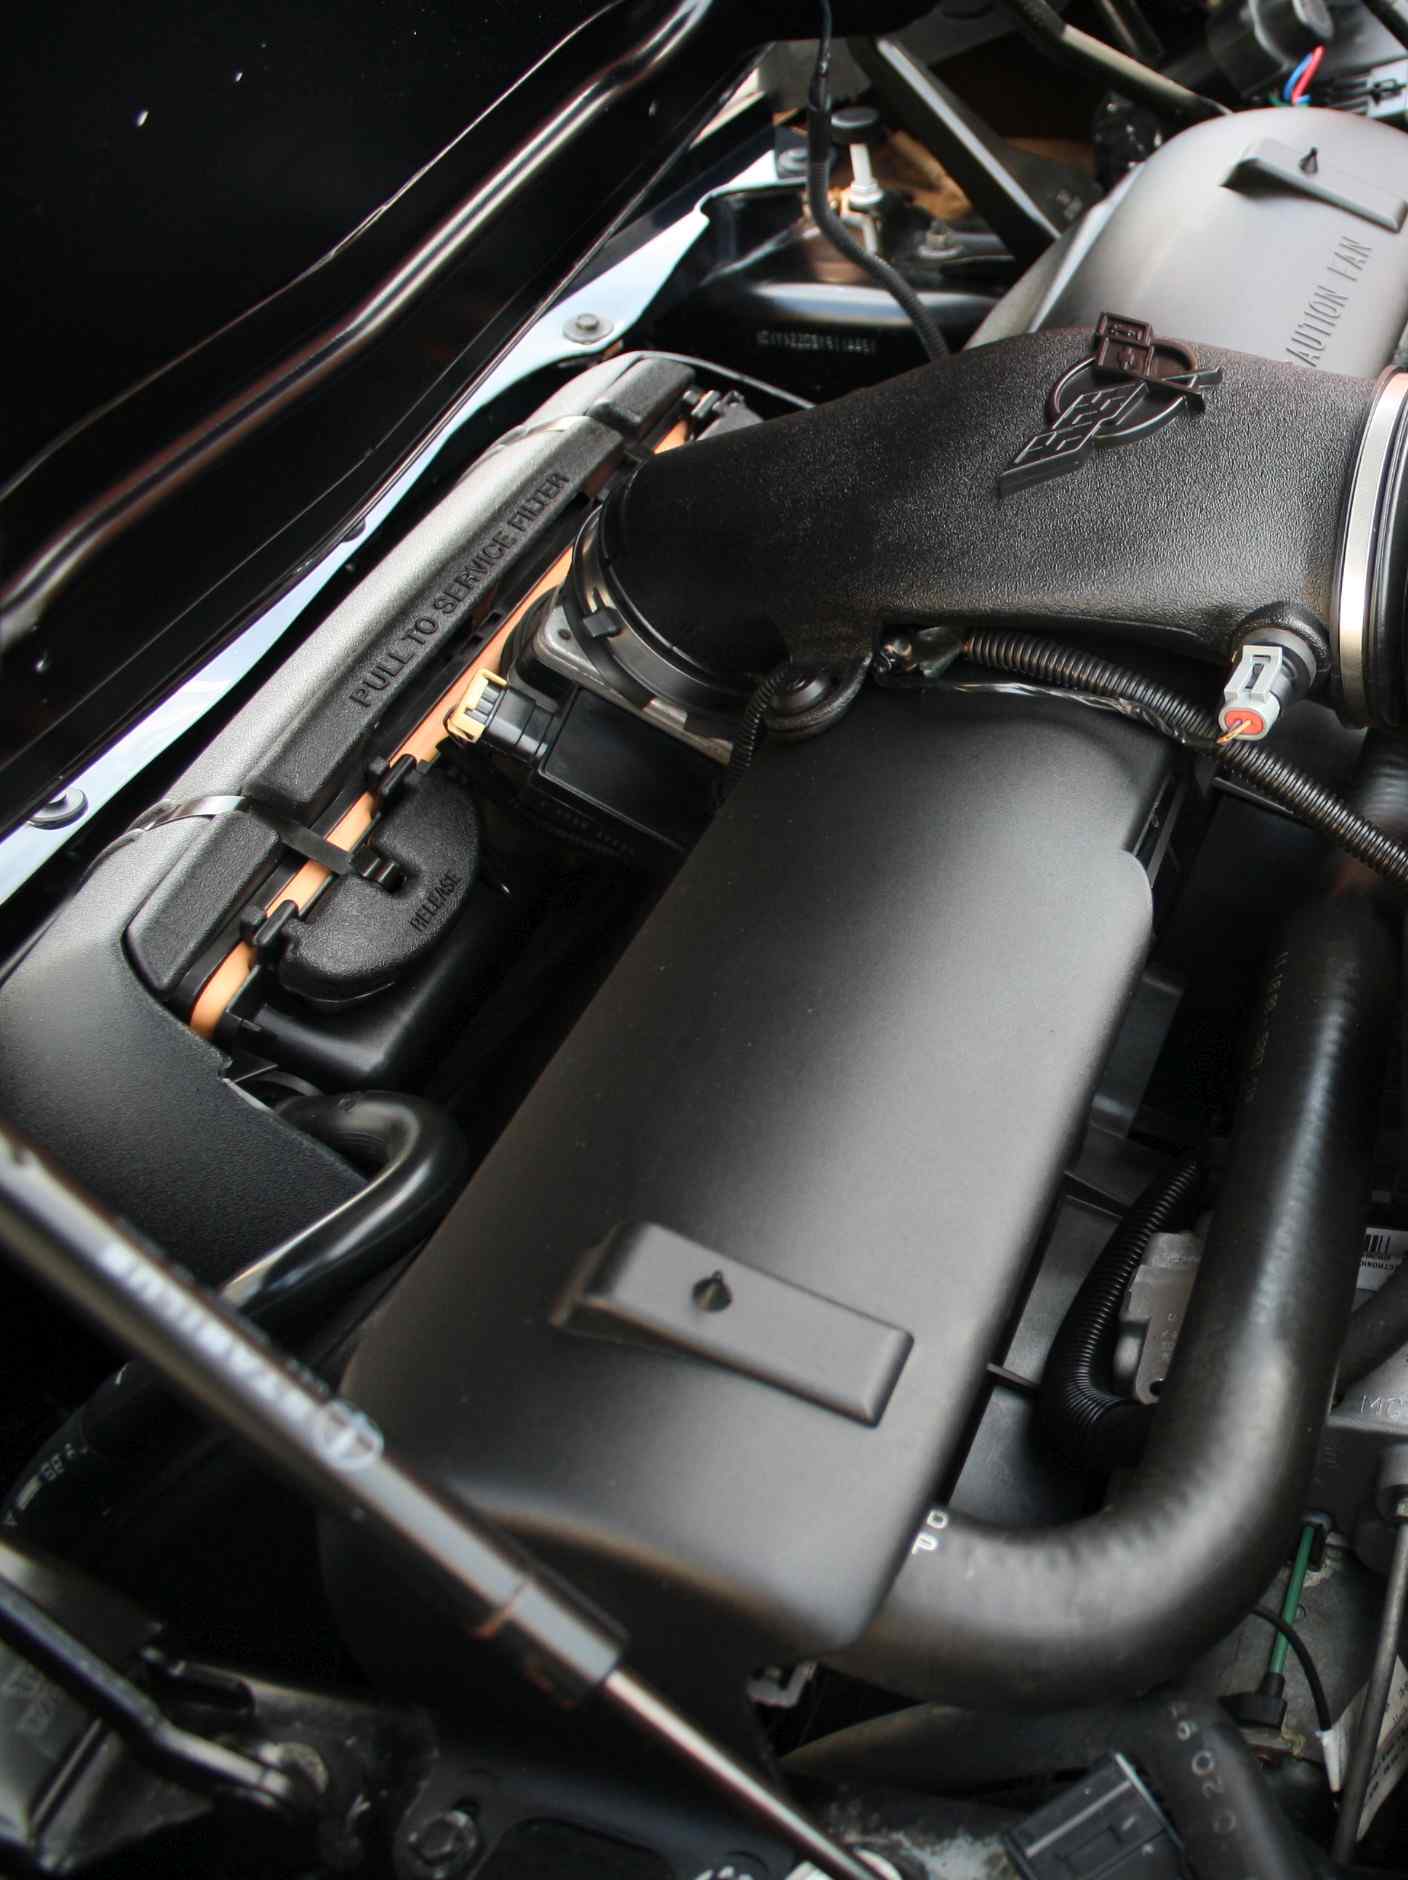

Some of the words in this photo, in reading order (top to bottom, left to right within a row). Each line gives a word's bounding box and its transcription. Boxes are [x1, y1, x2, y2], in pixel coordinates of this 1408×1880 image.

[1285, 284, 1350, 368] AUTION
[1326, 235, 1374, 283] FAN
[349, 647, 415, 708] PULL
[400, 614, 440, 646] TO
[433, 529, 511, 615] SERVICE
[507, 471, 570, 533] FILTER
[409, 871, 461, 933] RELEASE
